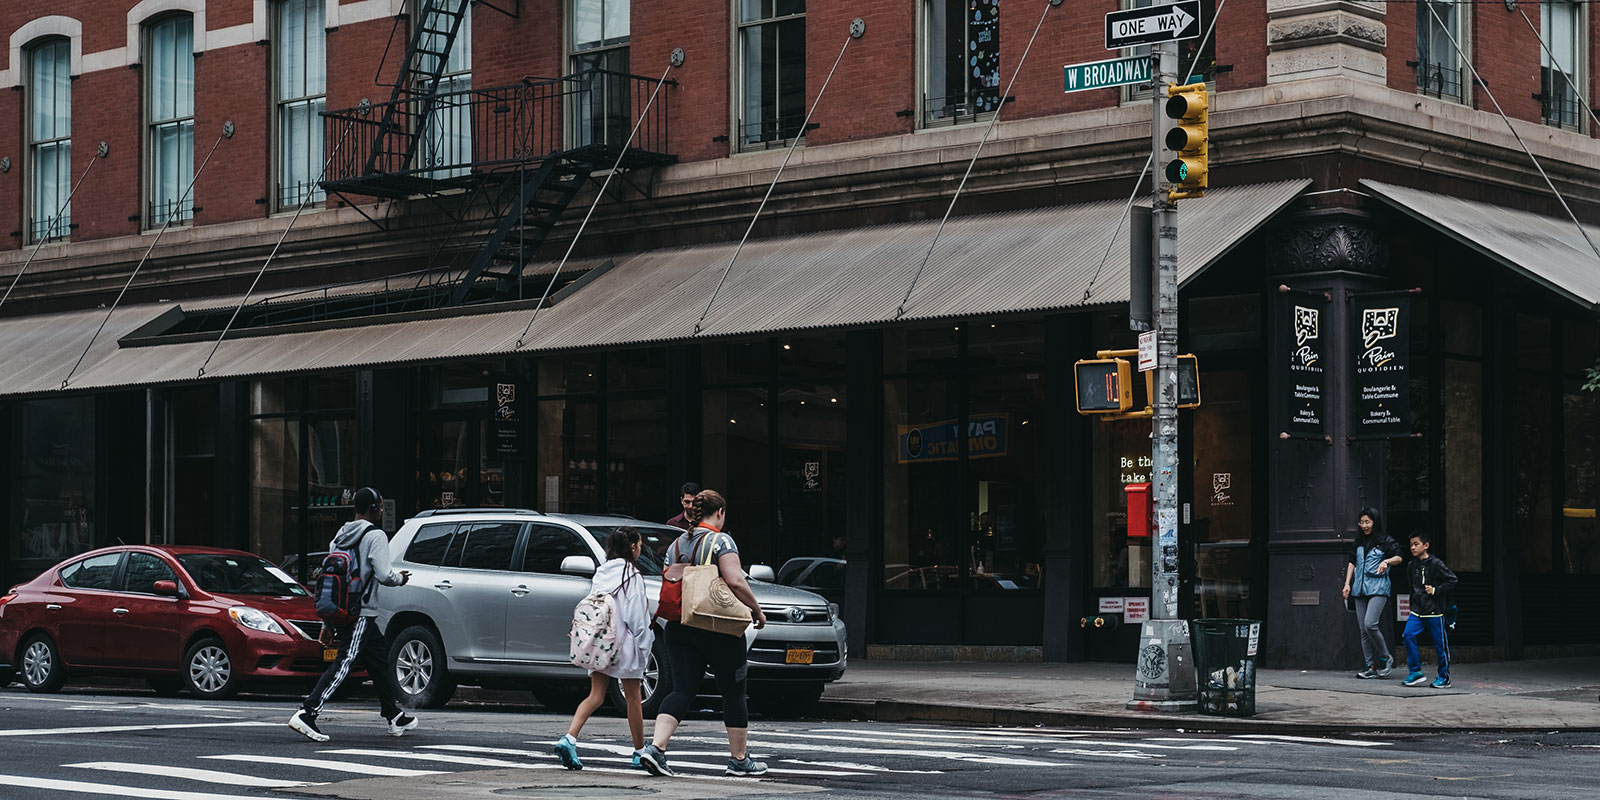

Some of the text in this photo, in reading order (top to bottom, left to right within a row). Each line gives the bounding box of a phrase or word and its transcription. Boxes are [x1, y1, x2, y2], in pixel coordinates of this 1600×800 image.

[1119, 13, 1185, 36] ONE WAY
[1068, 58, 1149, 89] W BROADWAY
[1296, 346, 1319, 365] Pain
[1362, 346, 1395, 366] Pain
[1357, 365, 1404, 373] QUOTIDIEN
[1120, 457, 1133, 468] Be
[1120, 472, 1146, 483] take
